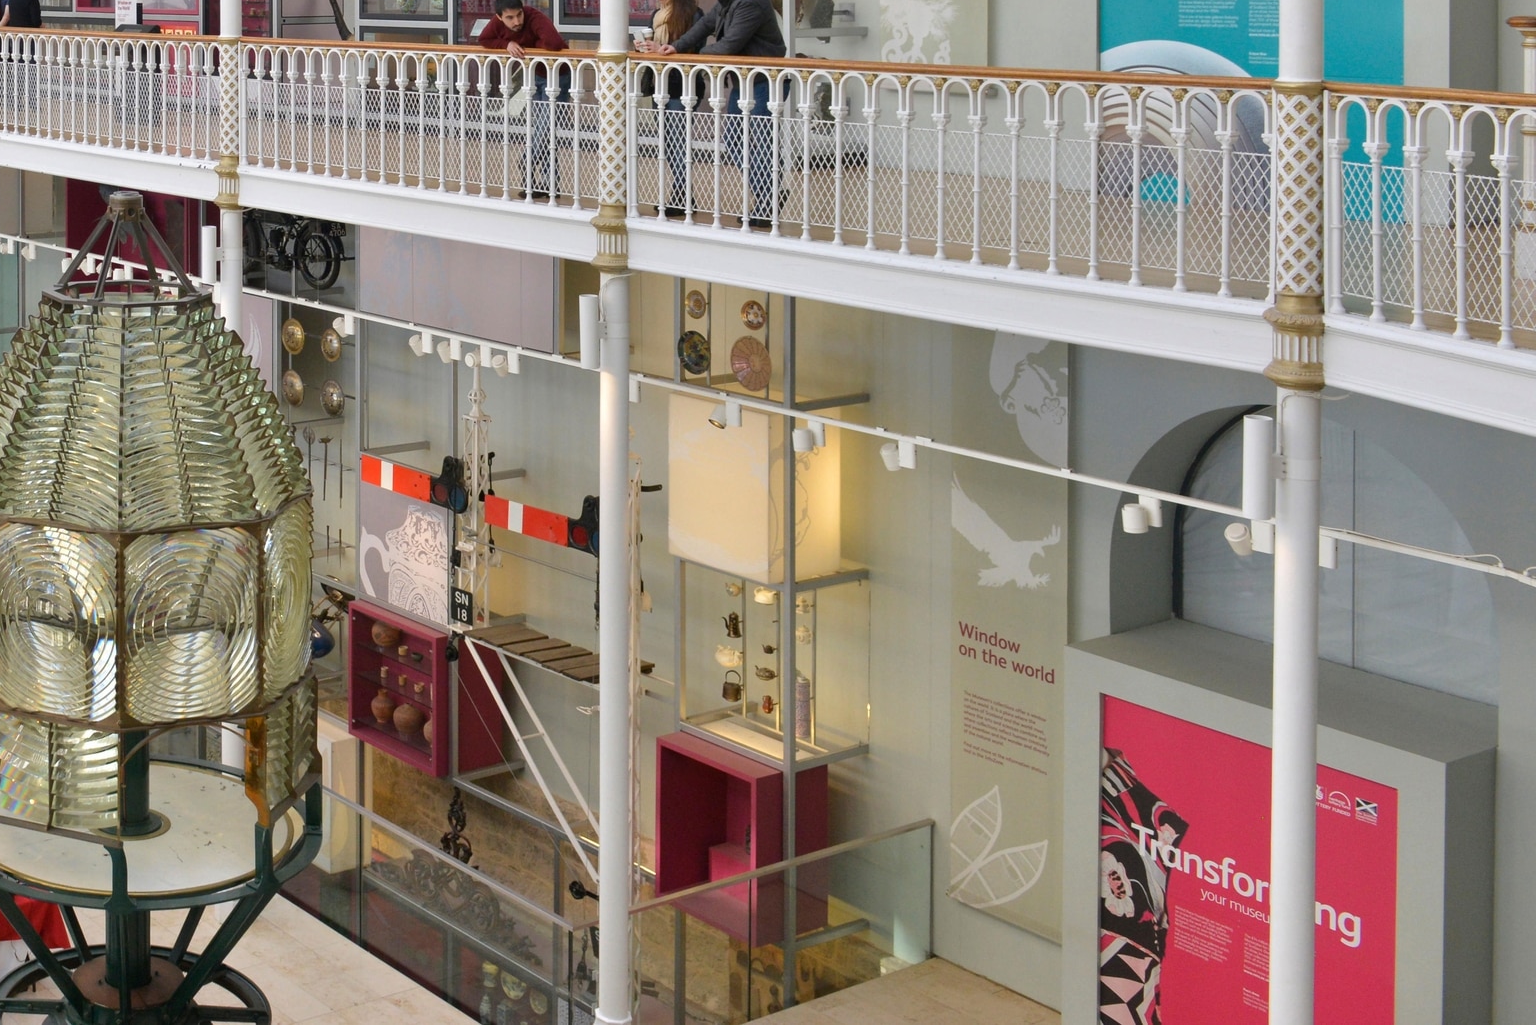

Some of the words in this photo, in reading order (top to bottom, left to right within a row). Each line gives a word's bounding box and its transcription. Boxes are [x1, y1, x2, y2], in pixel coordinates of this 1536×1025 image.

[455, 591, 469, 606] SN
[457, 607, 468, 621] 18
[958, 621, 1021, 653] Window
[959, 644, 977, 659] on
[982, 648, 1007, 669] the
[1012, 661, 1055, 684] world
[1131, 822, 1361, 948] Transforng
[1200, 888, 1227, 907] your
[1229, 898, 1270, 924] museu
